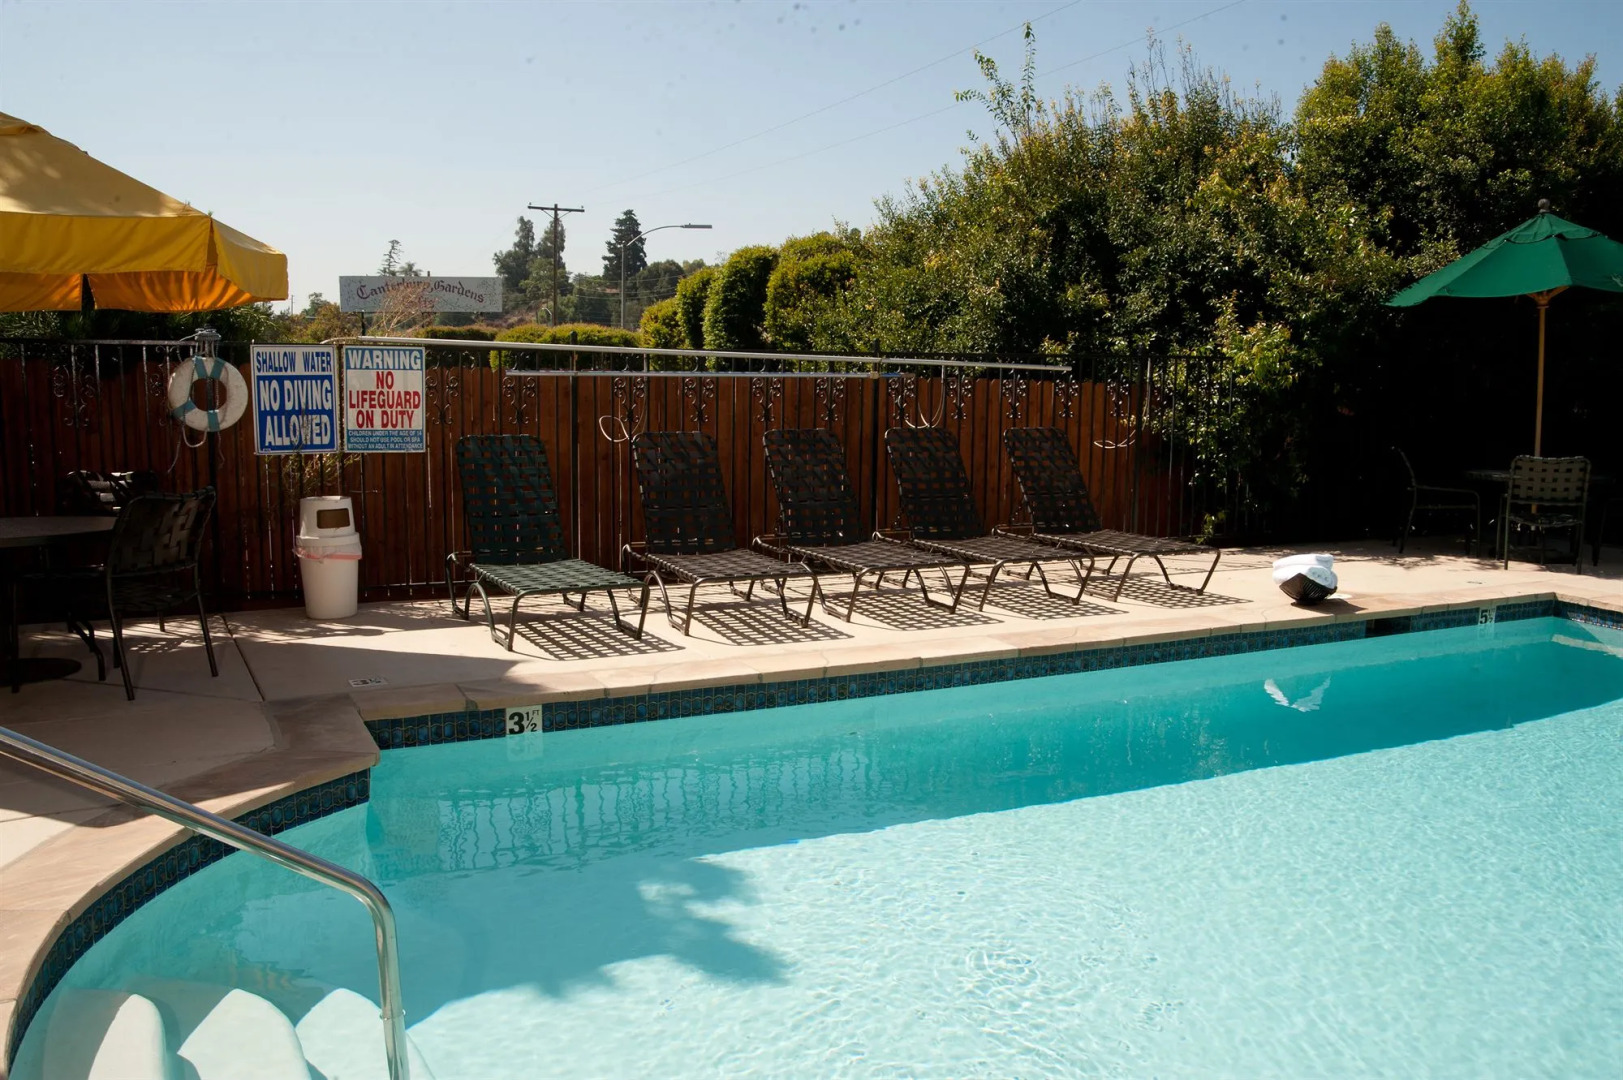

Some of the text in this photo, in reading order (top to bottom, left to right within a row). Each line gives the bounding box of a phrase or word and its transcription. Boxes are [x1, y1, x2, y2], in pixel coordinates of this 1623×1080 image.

[434, 279, 486, 304] Gardens
[256, 351, 332, 373] SHALLOW WATER
[348, 349, 421, 370] WARNING
[376, 371, 394, 390] NO
[260, 379, 332, 411] NO DIVING
[349, 390, 421, 409] LIFEGUARD
[356, 409, 414, 429] ON DUTY
[265, 414, 331, 446] ALLOWED
